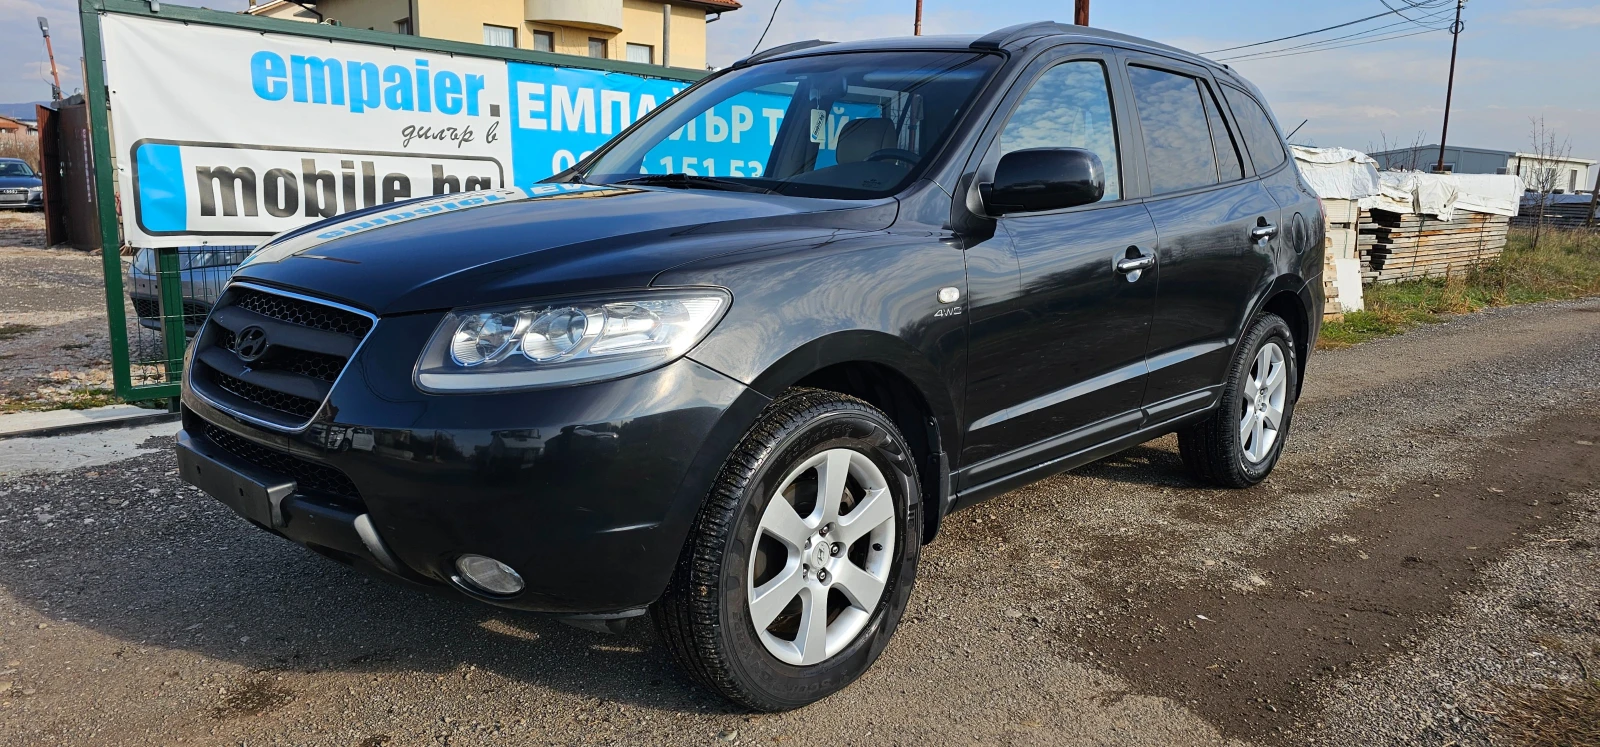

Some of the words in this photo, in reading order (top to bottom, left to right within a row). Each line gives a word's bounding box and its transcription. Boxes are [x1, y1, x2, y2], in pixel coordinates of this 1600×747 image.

[401, 124, 475, 149] дилър
[486, 120, 499, 144] в
[660, 156, 715, 178] 151
[195, 158, 492, 219] mobileb
